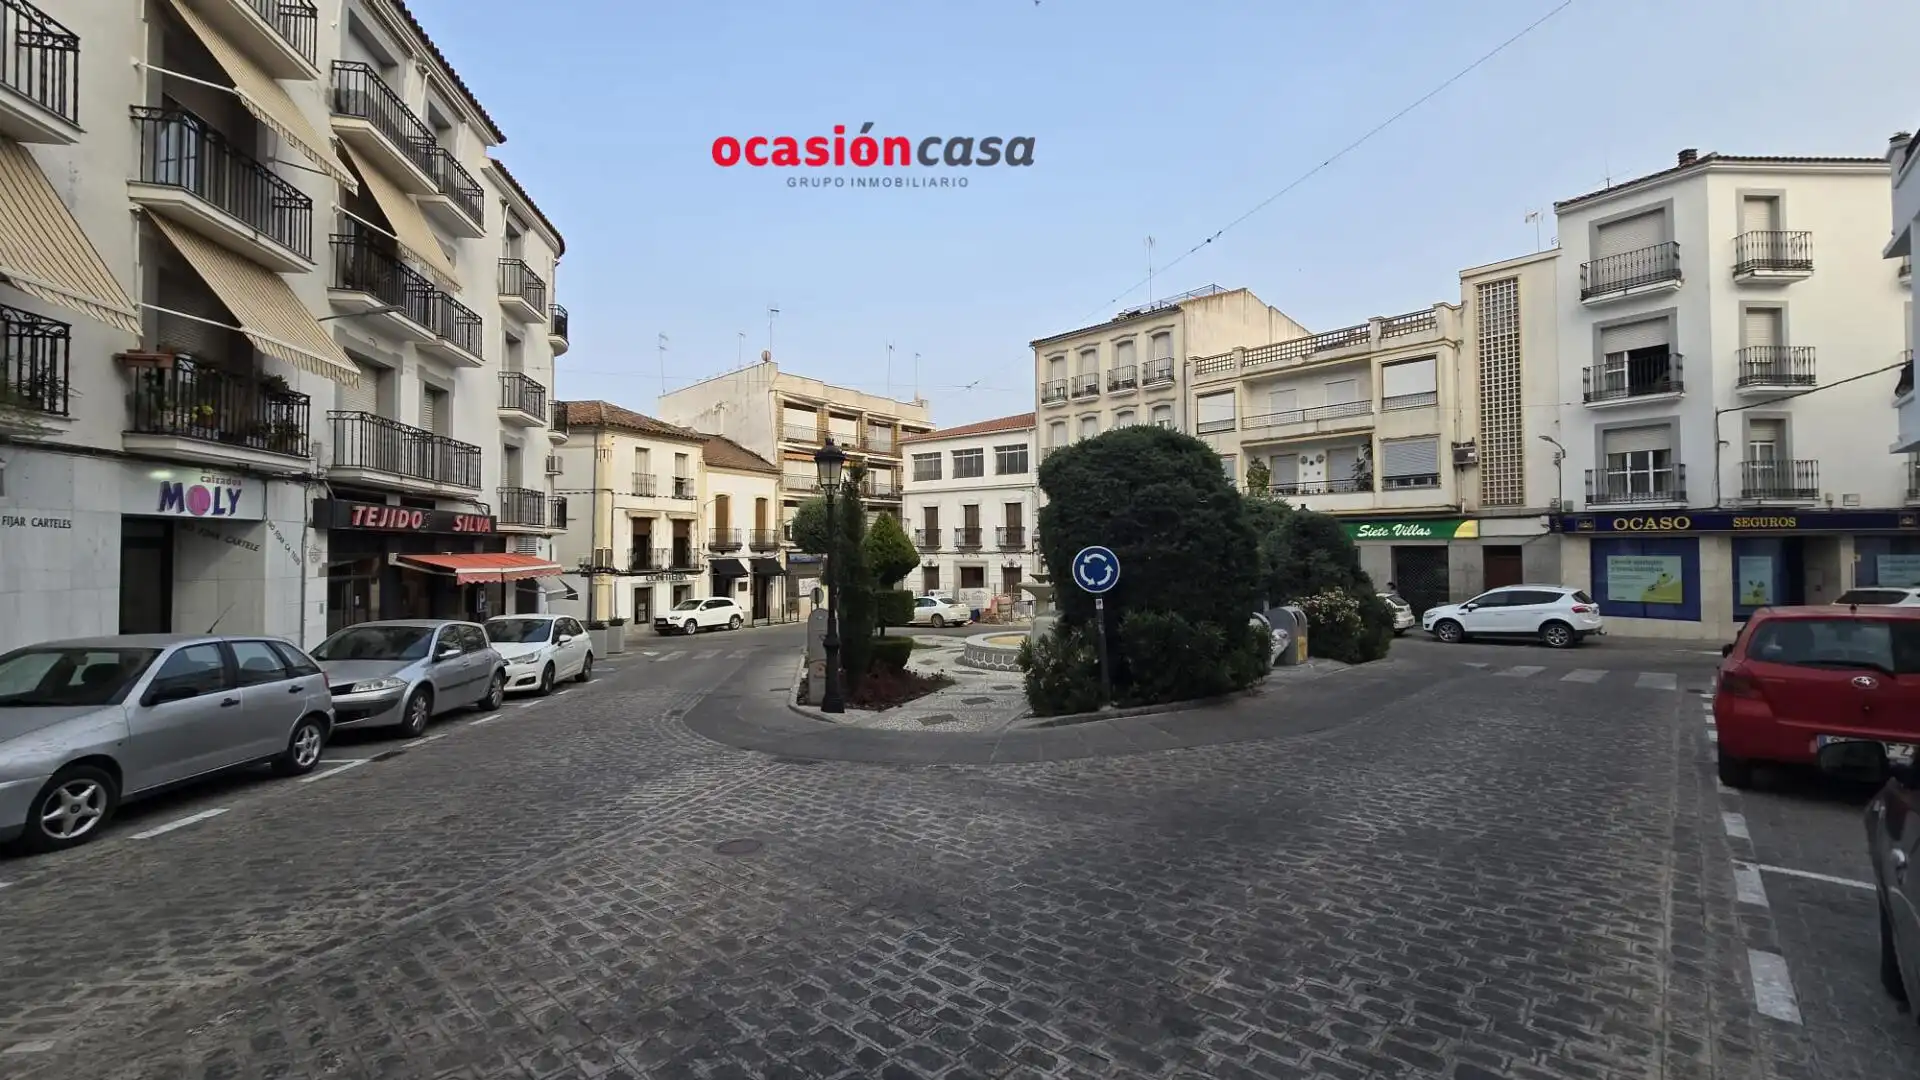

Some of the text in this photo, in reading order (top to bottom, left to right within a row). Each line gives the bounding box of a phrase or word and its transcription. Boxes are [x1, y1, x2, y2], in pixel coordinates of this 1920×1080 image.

[157, 480, 242, 516] MOLY
[2, 515, 72, 529] FIJAR CARTELES
[452, 514, 492, 533] SILVA
[1613, 516, 1797, 531] OCASO SEGUROS
[1357, 523, 1432, 538] Siete Villas
